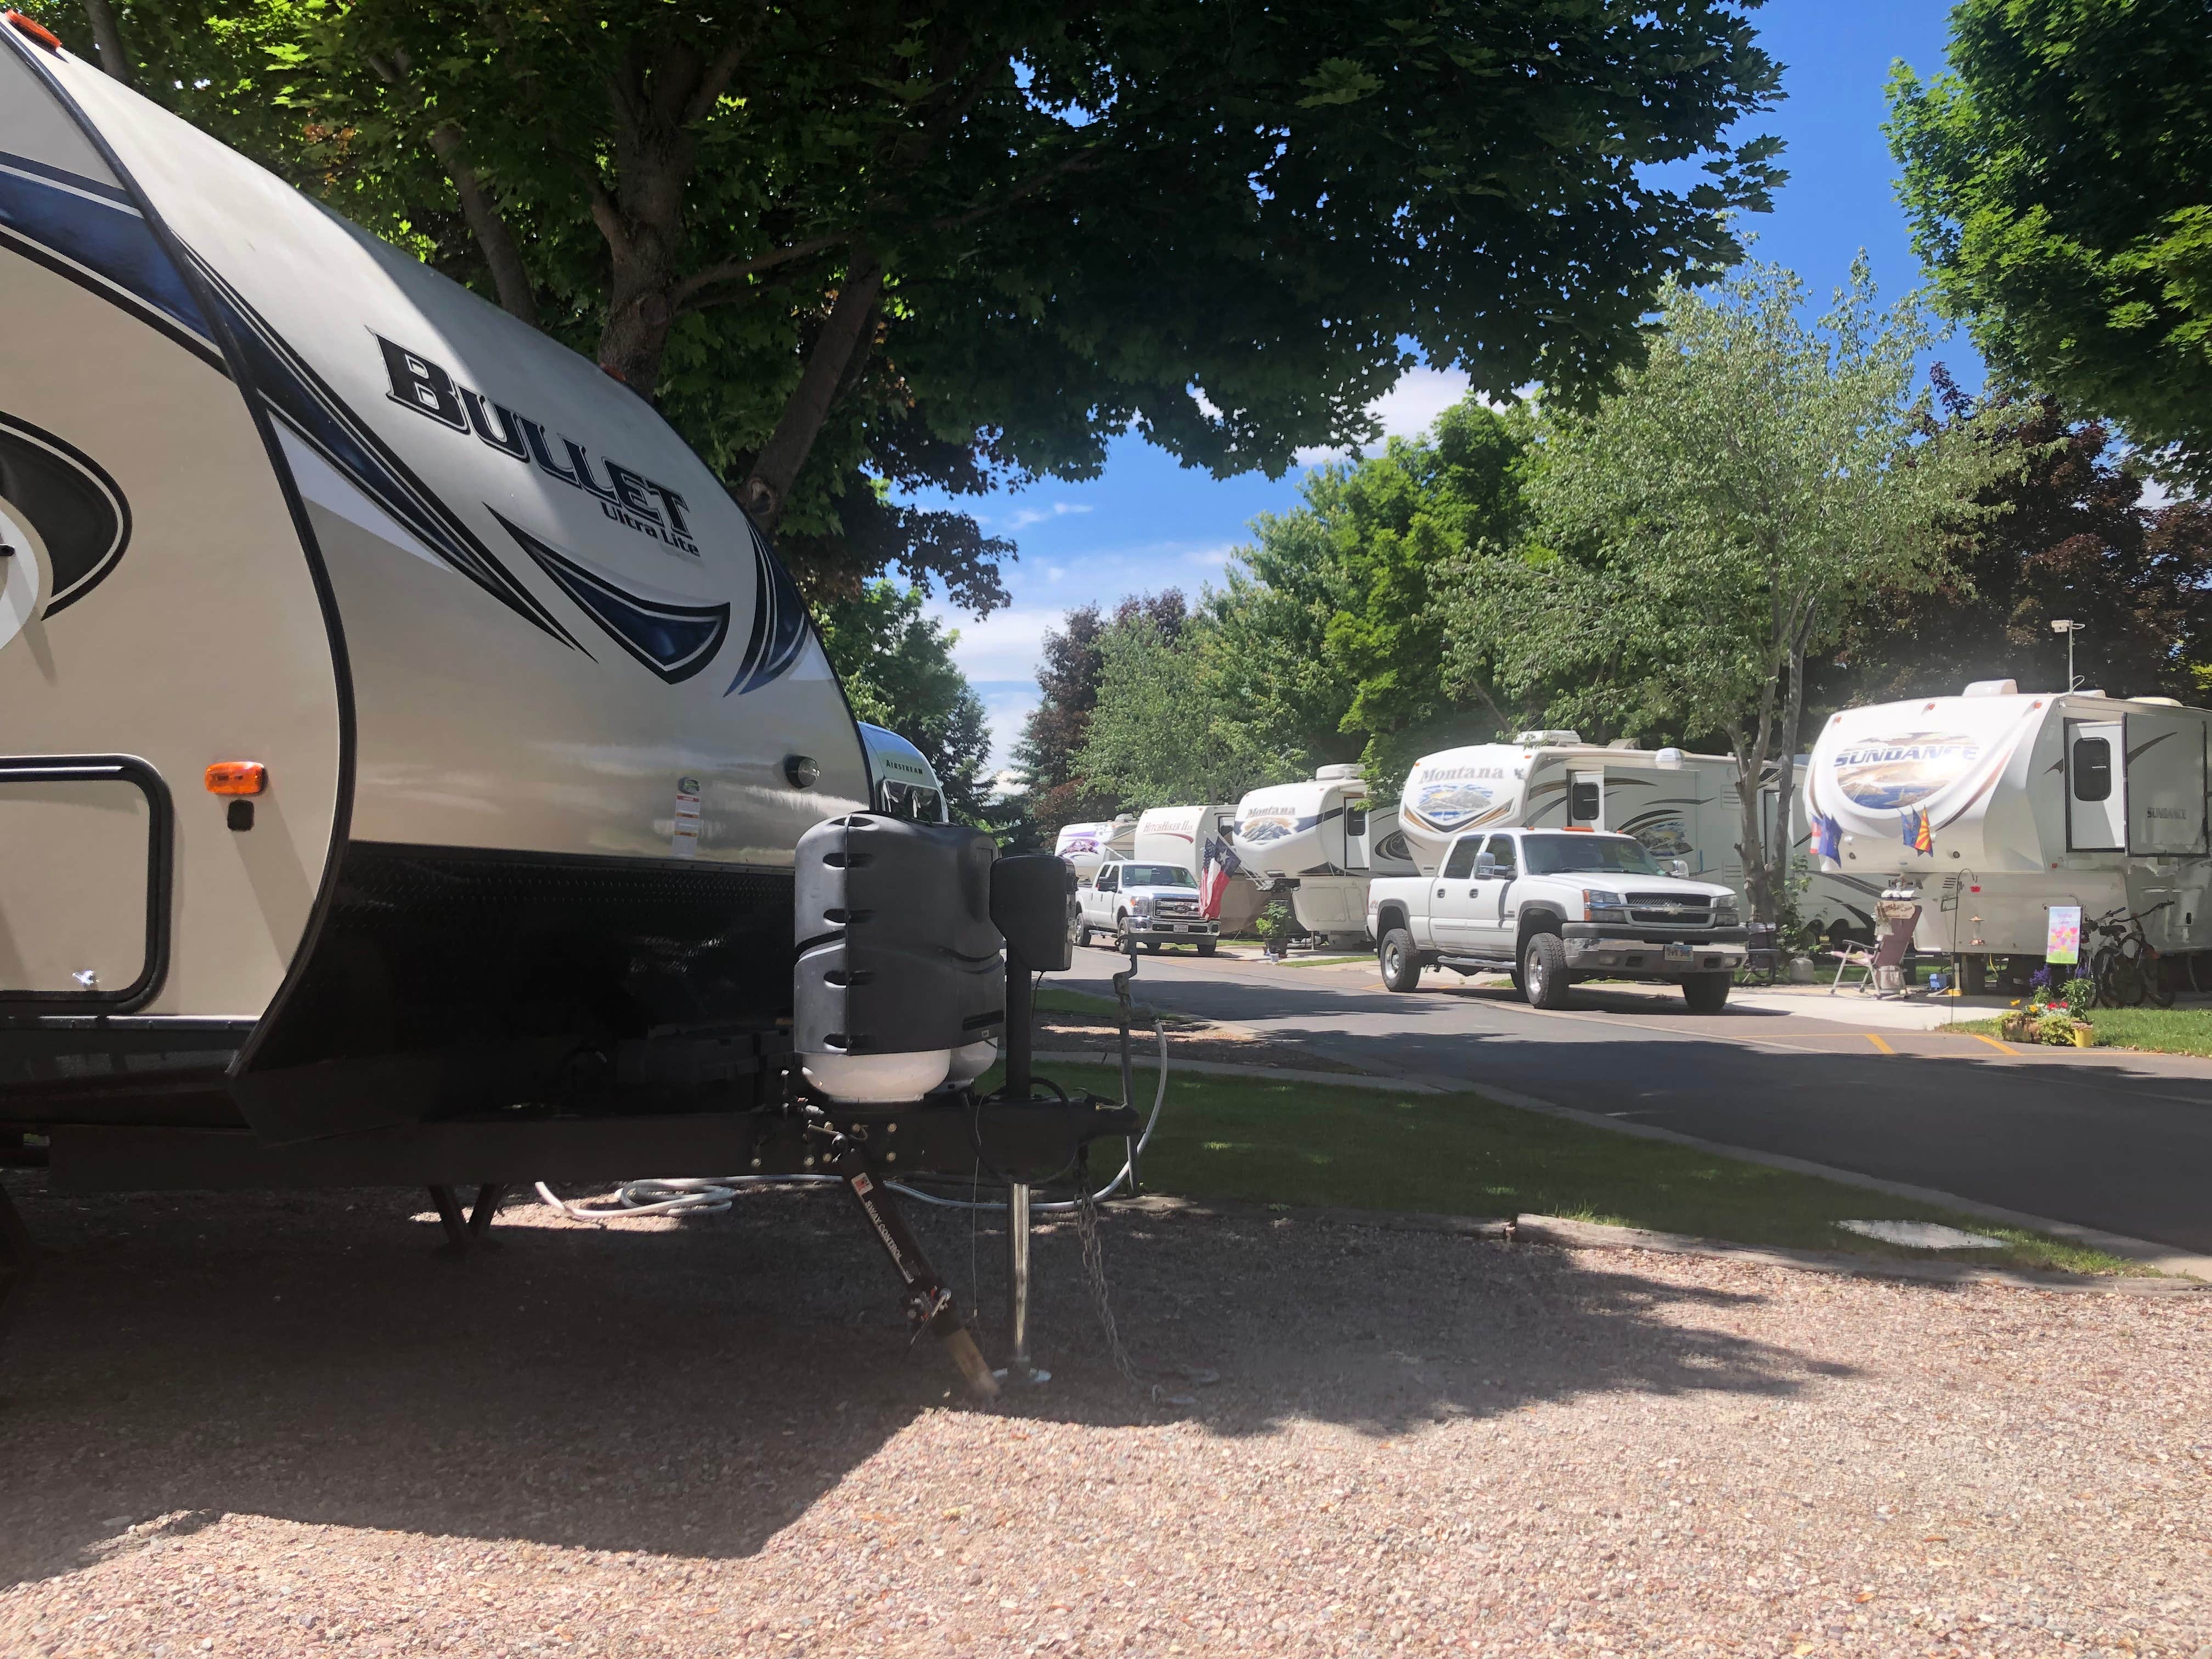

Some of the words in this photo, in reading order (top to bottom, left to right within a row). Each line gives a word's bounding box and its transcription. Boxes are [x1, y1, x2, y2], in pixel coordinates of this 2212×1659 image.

[364, 325, 693, 540] BULLET
[601, 501, 658, 539] Ultra
[661, 528, 700, 557] Lite
[885, 759, 923, 774] AIRSTREAM
[1833, 746, 1979, 767] SUNDANCE
[1418, 765, 1504, 783] Montana
[1246, 805, 1295, 818] Montana
[864, 1200, 882, 1224] SWAY
[878, 1223, 902, 1262] CONTROL
